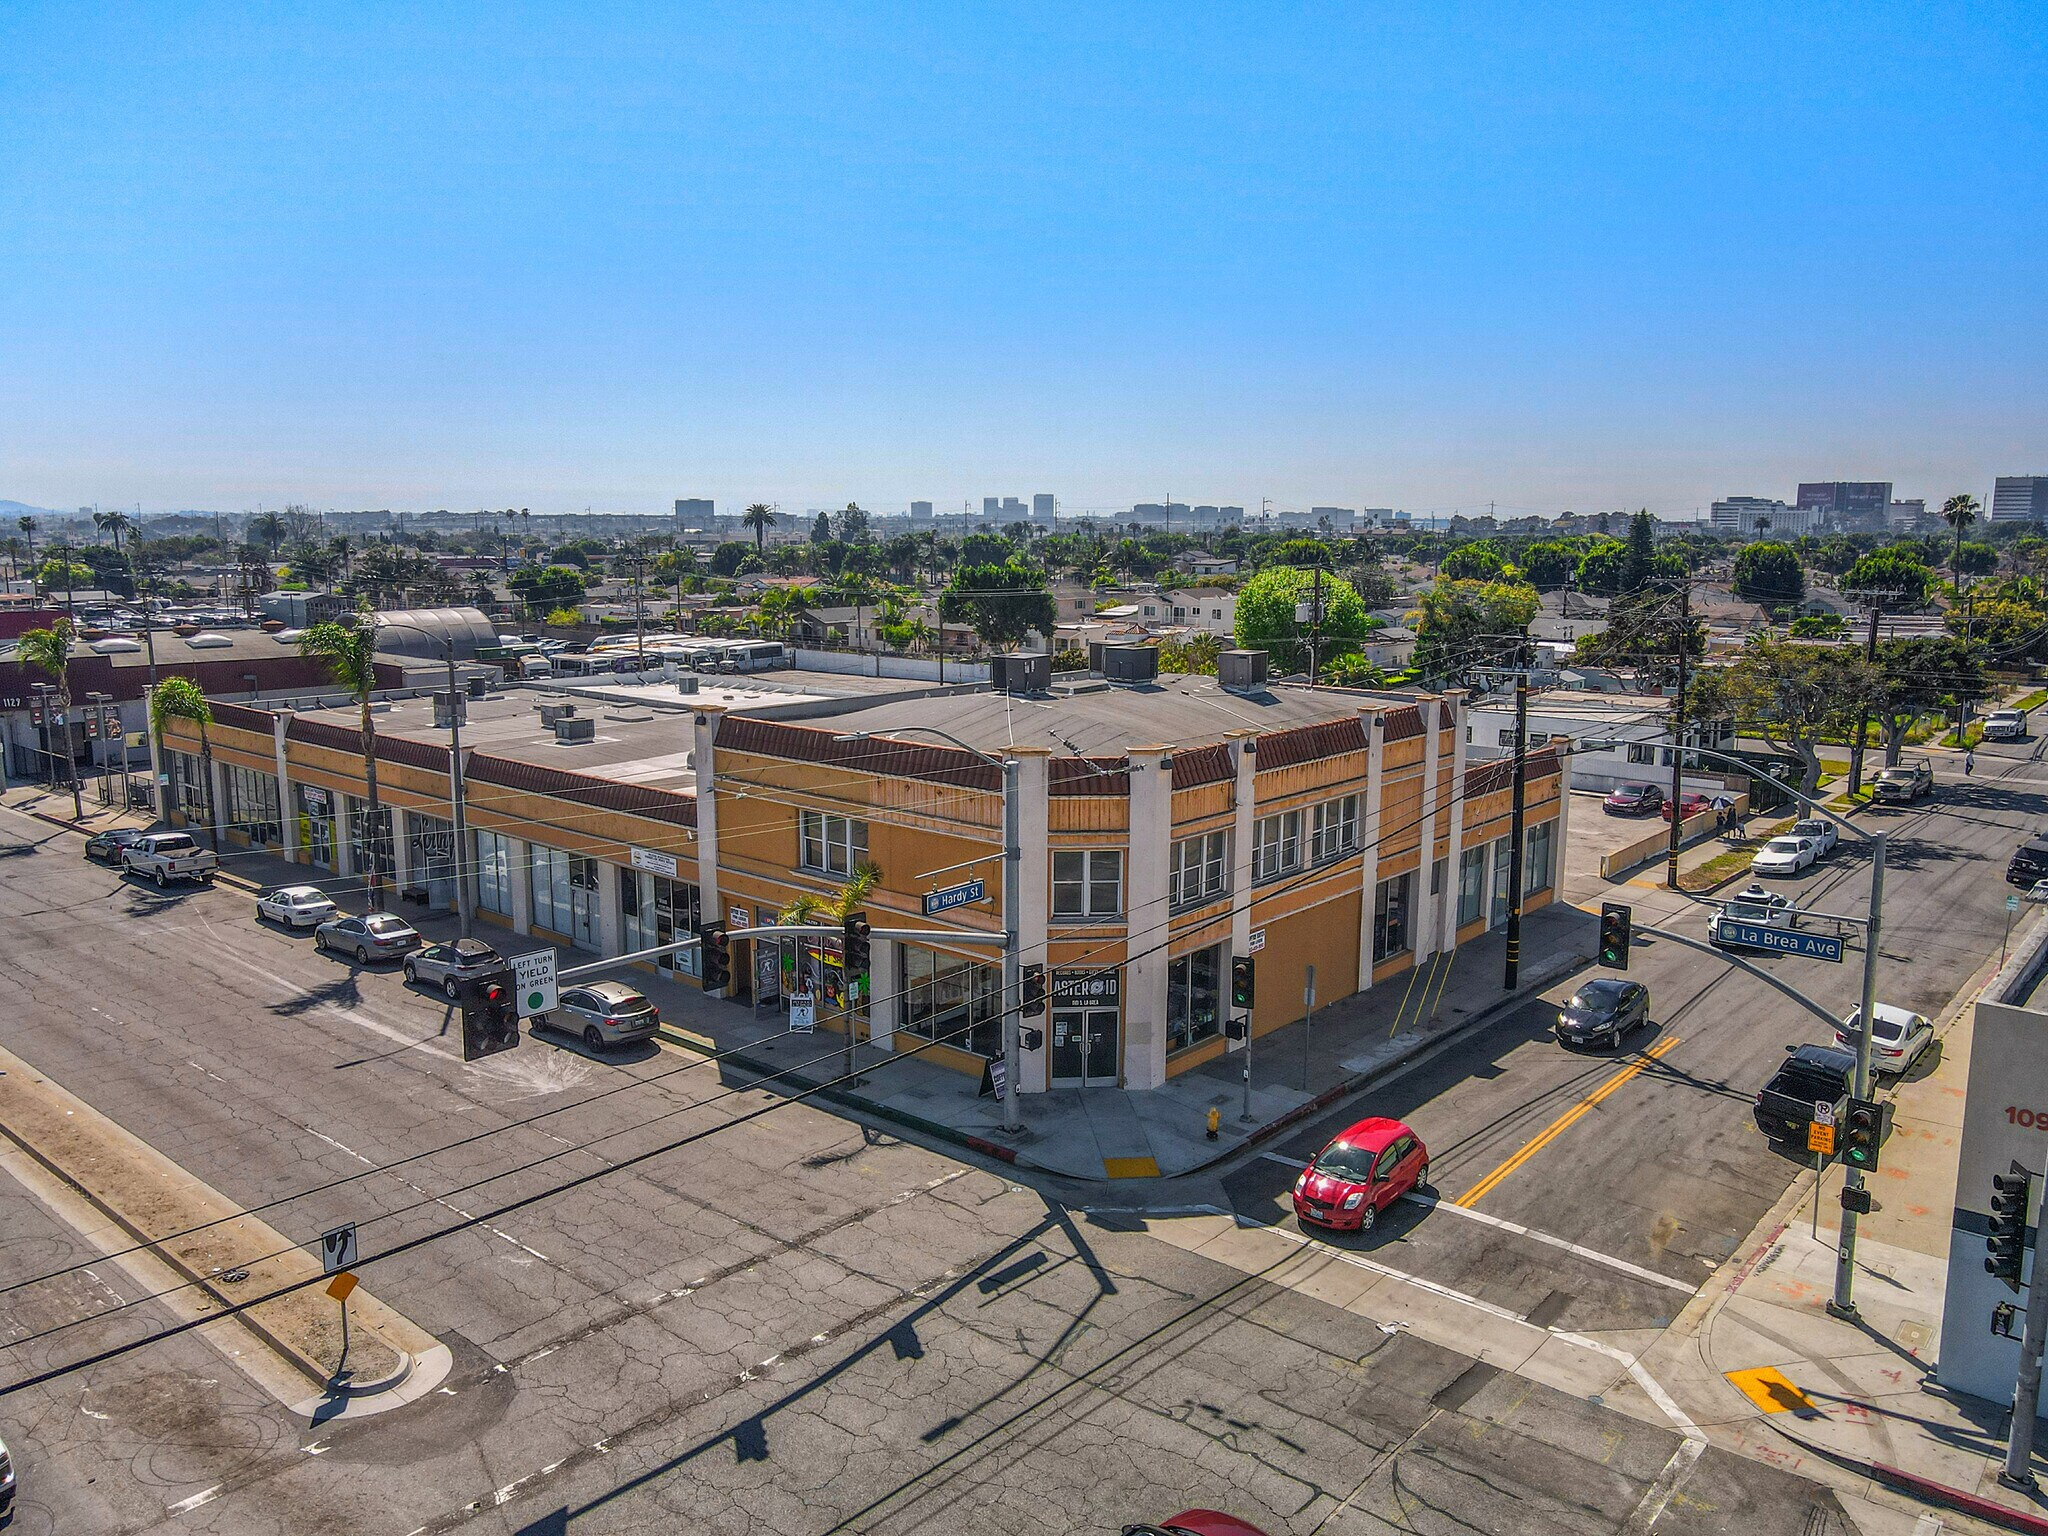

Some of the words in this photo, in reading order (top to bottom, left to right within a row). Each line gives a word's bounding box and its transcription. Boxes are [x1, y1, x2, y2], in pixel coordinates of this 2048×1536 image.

[3, 698, 21, 707] 1129
[942, 890, 968, 906] Hardy
[970, 886, 979, 897] St
[1741, 928, 1758, 942] La
[1763, 932, 1798, 949] Brea
[1805, 940, 1836, 955] Ave
[514, 960, 531, 970] LEFT
[534, 955, 553, 965] TURN
[520, 966, 549, 979] YIELD
[516, 983, 526, 991] ON
[530, 976, 554, 988] GREEN
[2005, 1106, 2048, 1131] 109
[1811, 1135, 1831, 1143] PARKING
